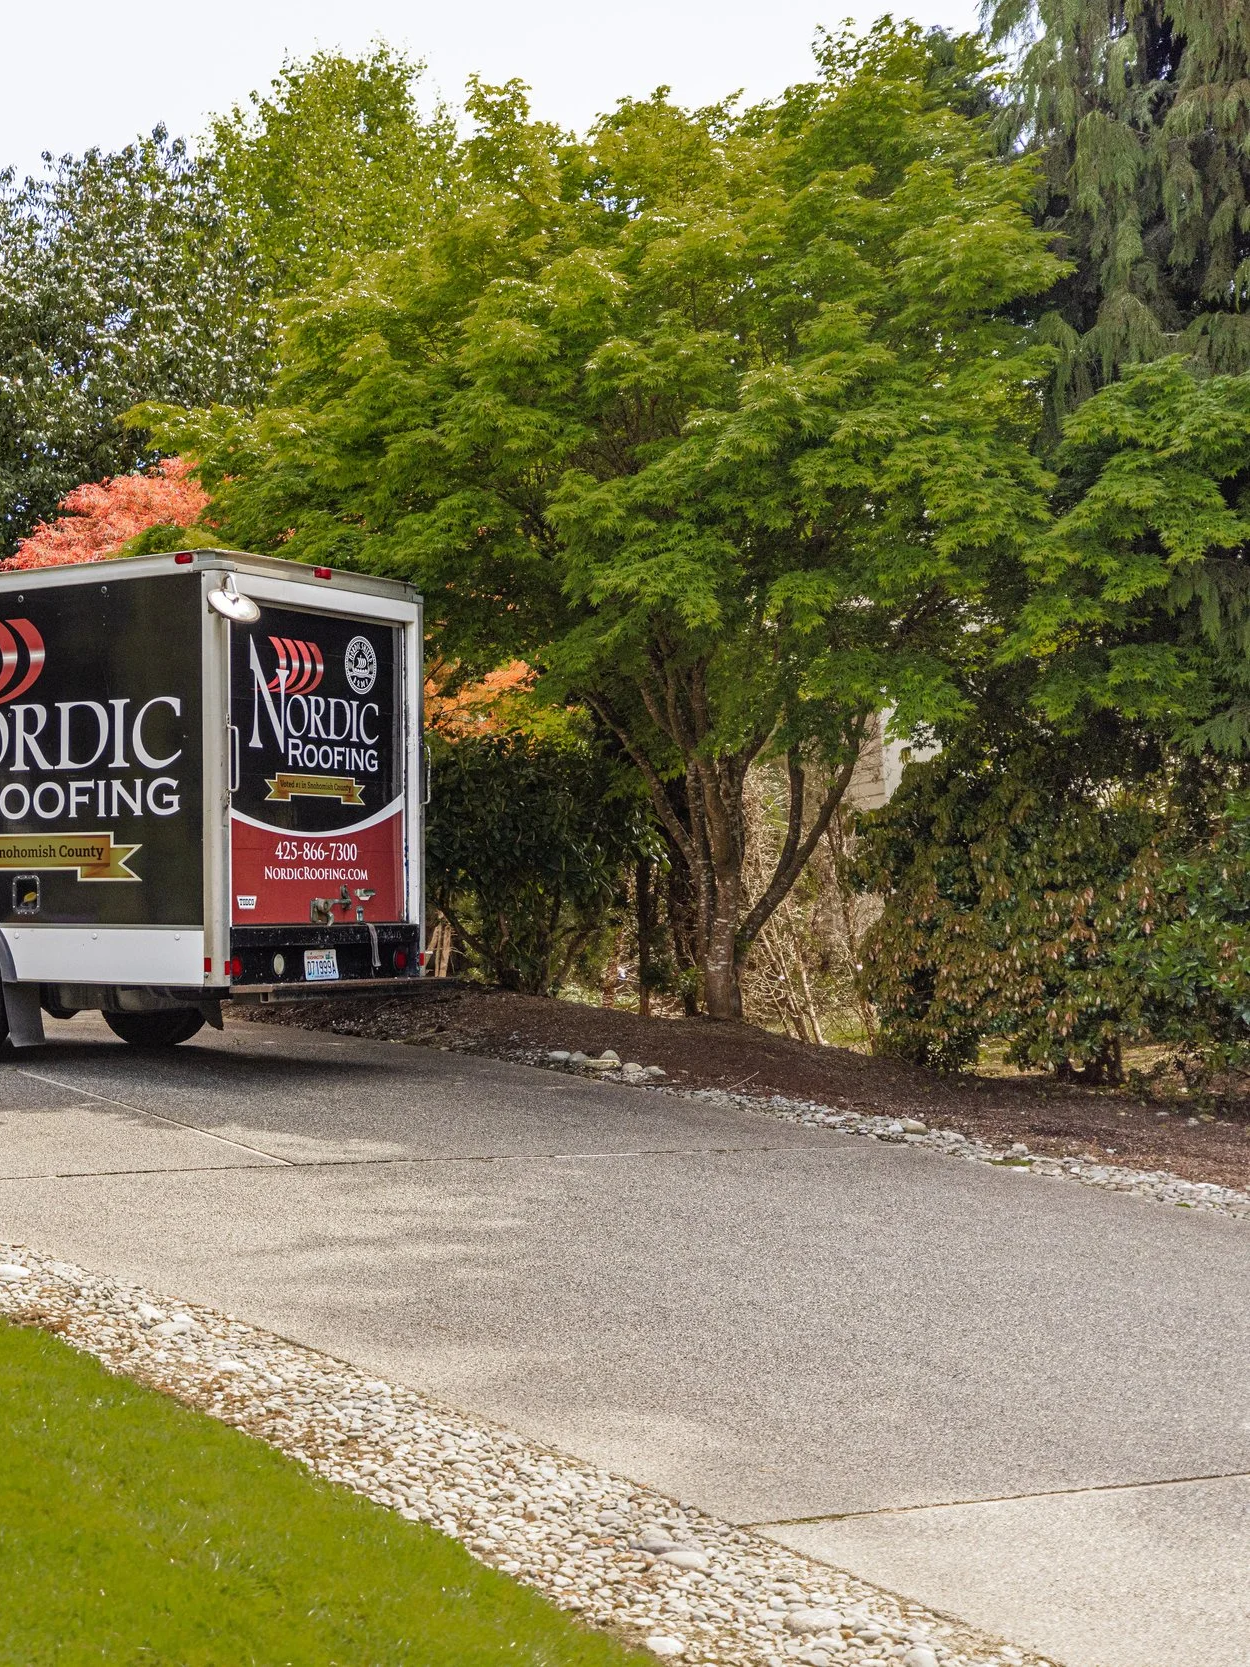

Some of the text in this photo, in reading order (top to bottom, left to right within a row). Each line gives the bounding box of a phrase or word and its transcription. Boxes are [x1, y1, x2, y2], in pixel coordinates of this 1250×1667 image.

[249, 633, 379, 754] NORDIC
[288, 738, 379, 772] ROOFING
[280, 780, 295, 788] Voted
[308, 782, 333, 790] Snohomish
[334, 784, 352, 793] County
[58, 845, 104, 860] County
[275, 841, 357, 861] 425-866-7300
[264, 866, 368, 880] NORDICROOFING.COM
